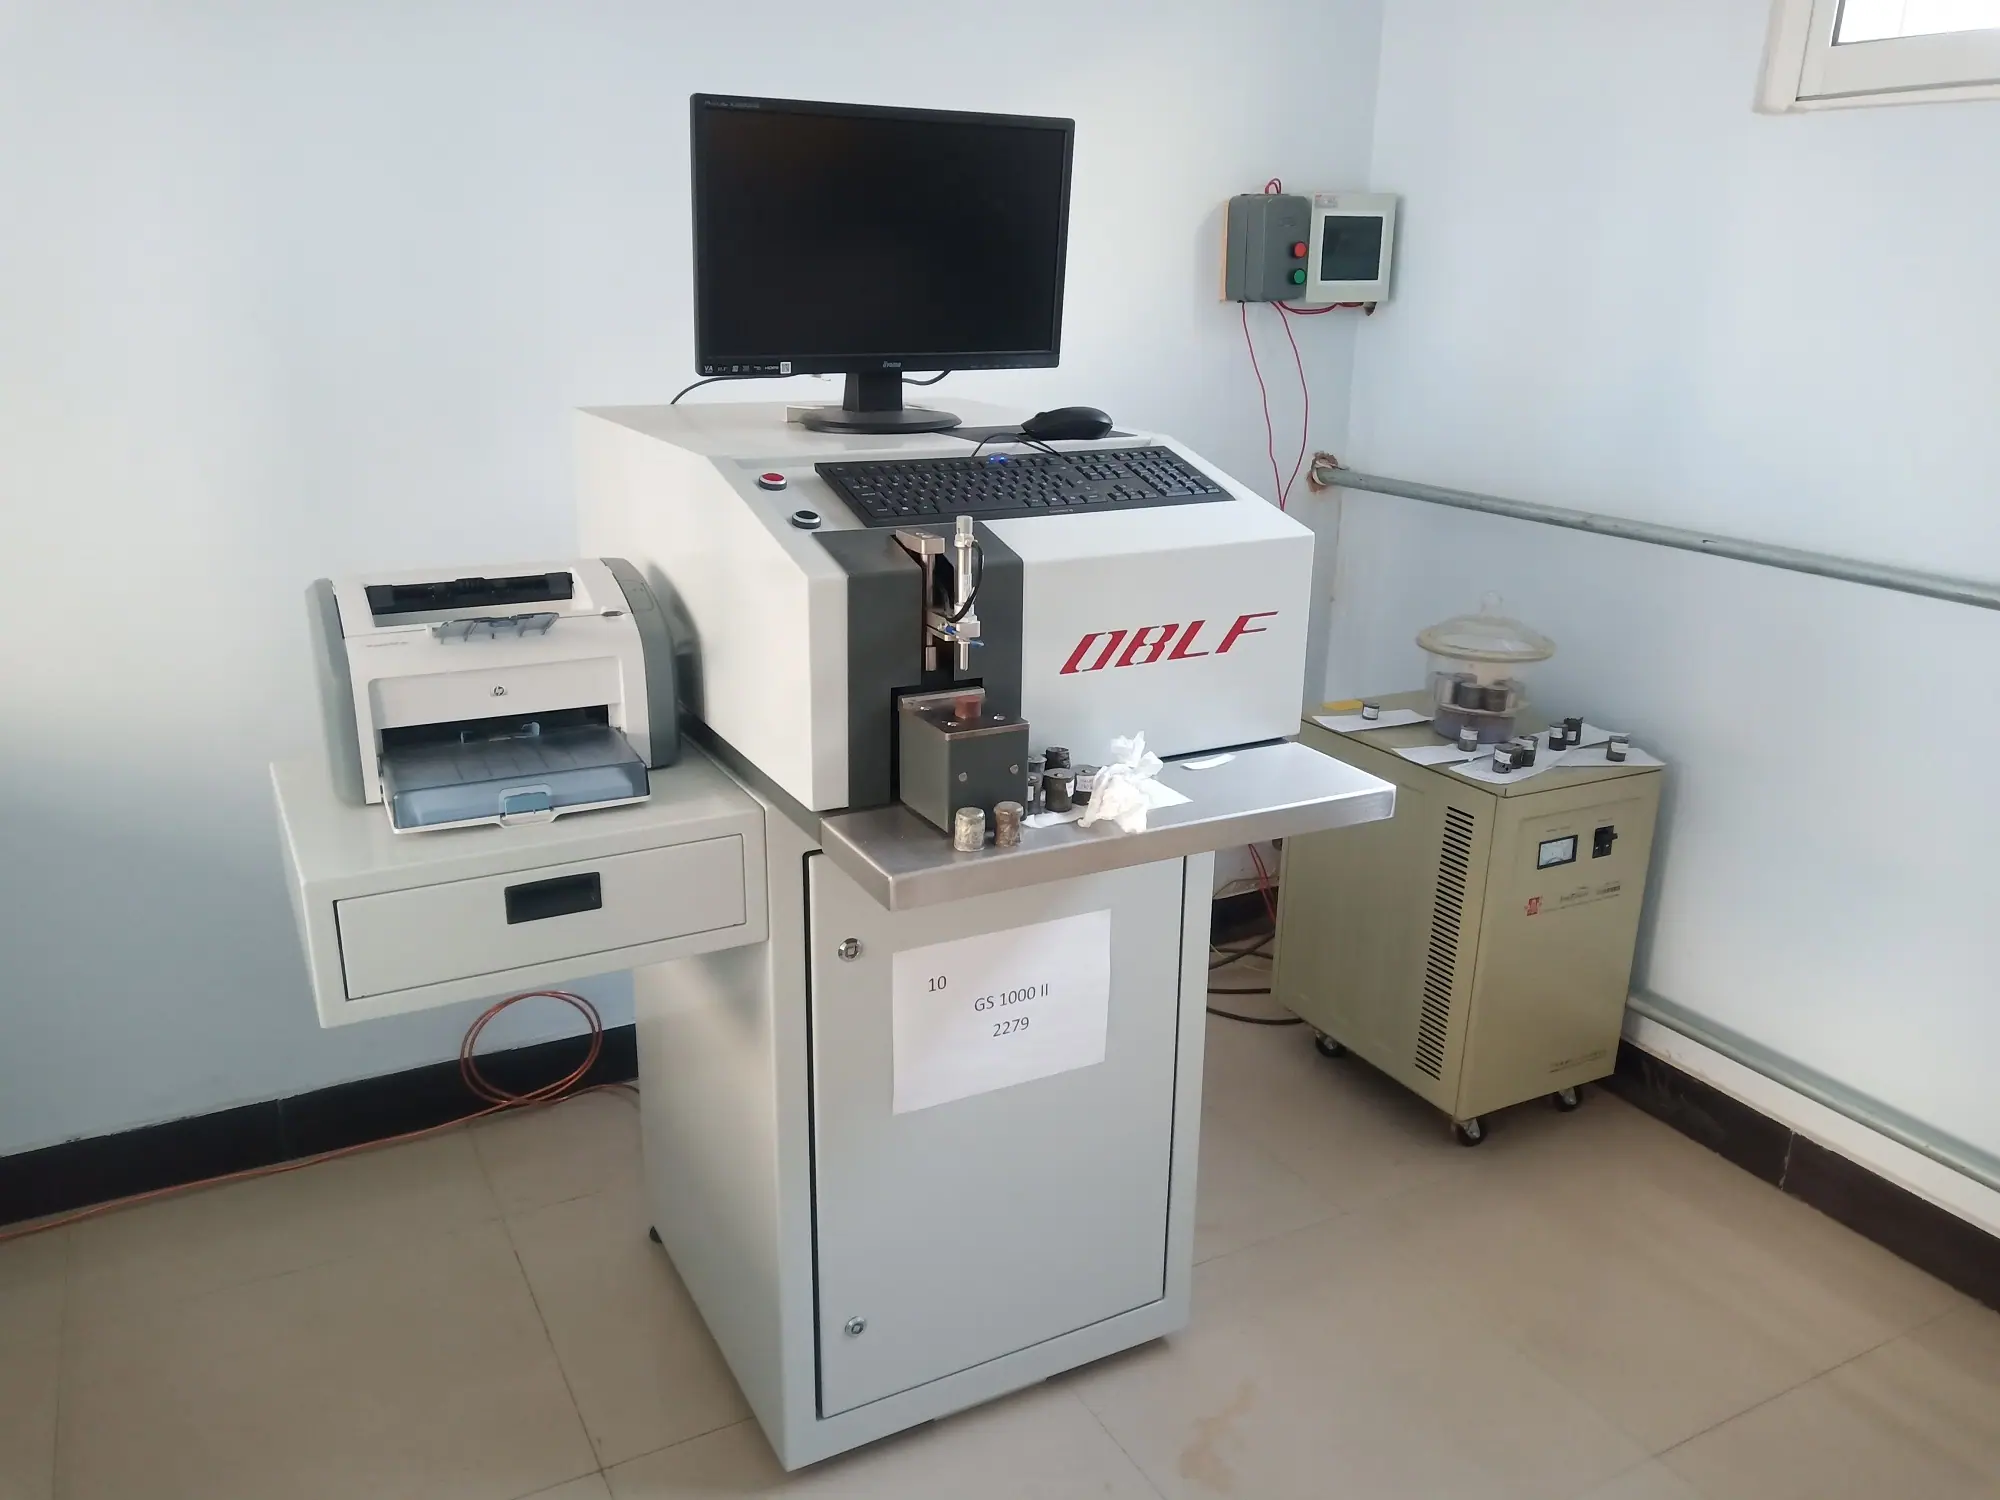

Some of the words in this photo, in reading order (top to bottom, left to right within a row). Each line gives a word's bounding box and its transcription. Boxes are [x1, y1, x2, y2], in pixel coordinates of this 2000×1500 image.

[1059, 610, 1279, 675] OBLF
[928, 975, 947, 992] 10
[974, 995, 994, 1011] GS
[1000, 986, 1036, 1006] 1000
[1041, 983, 1049, 996] II
[992, 1016, 1030, 1037] 2279
